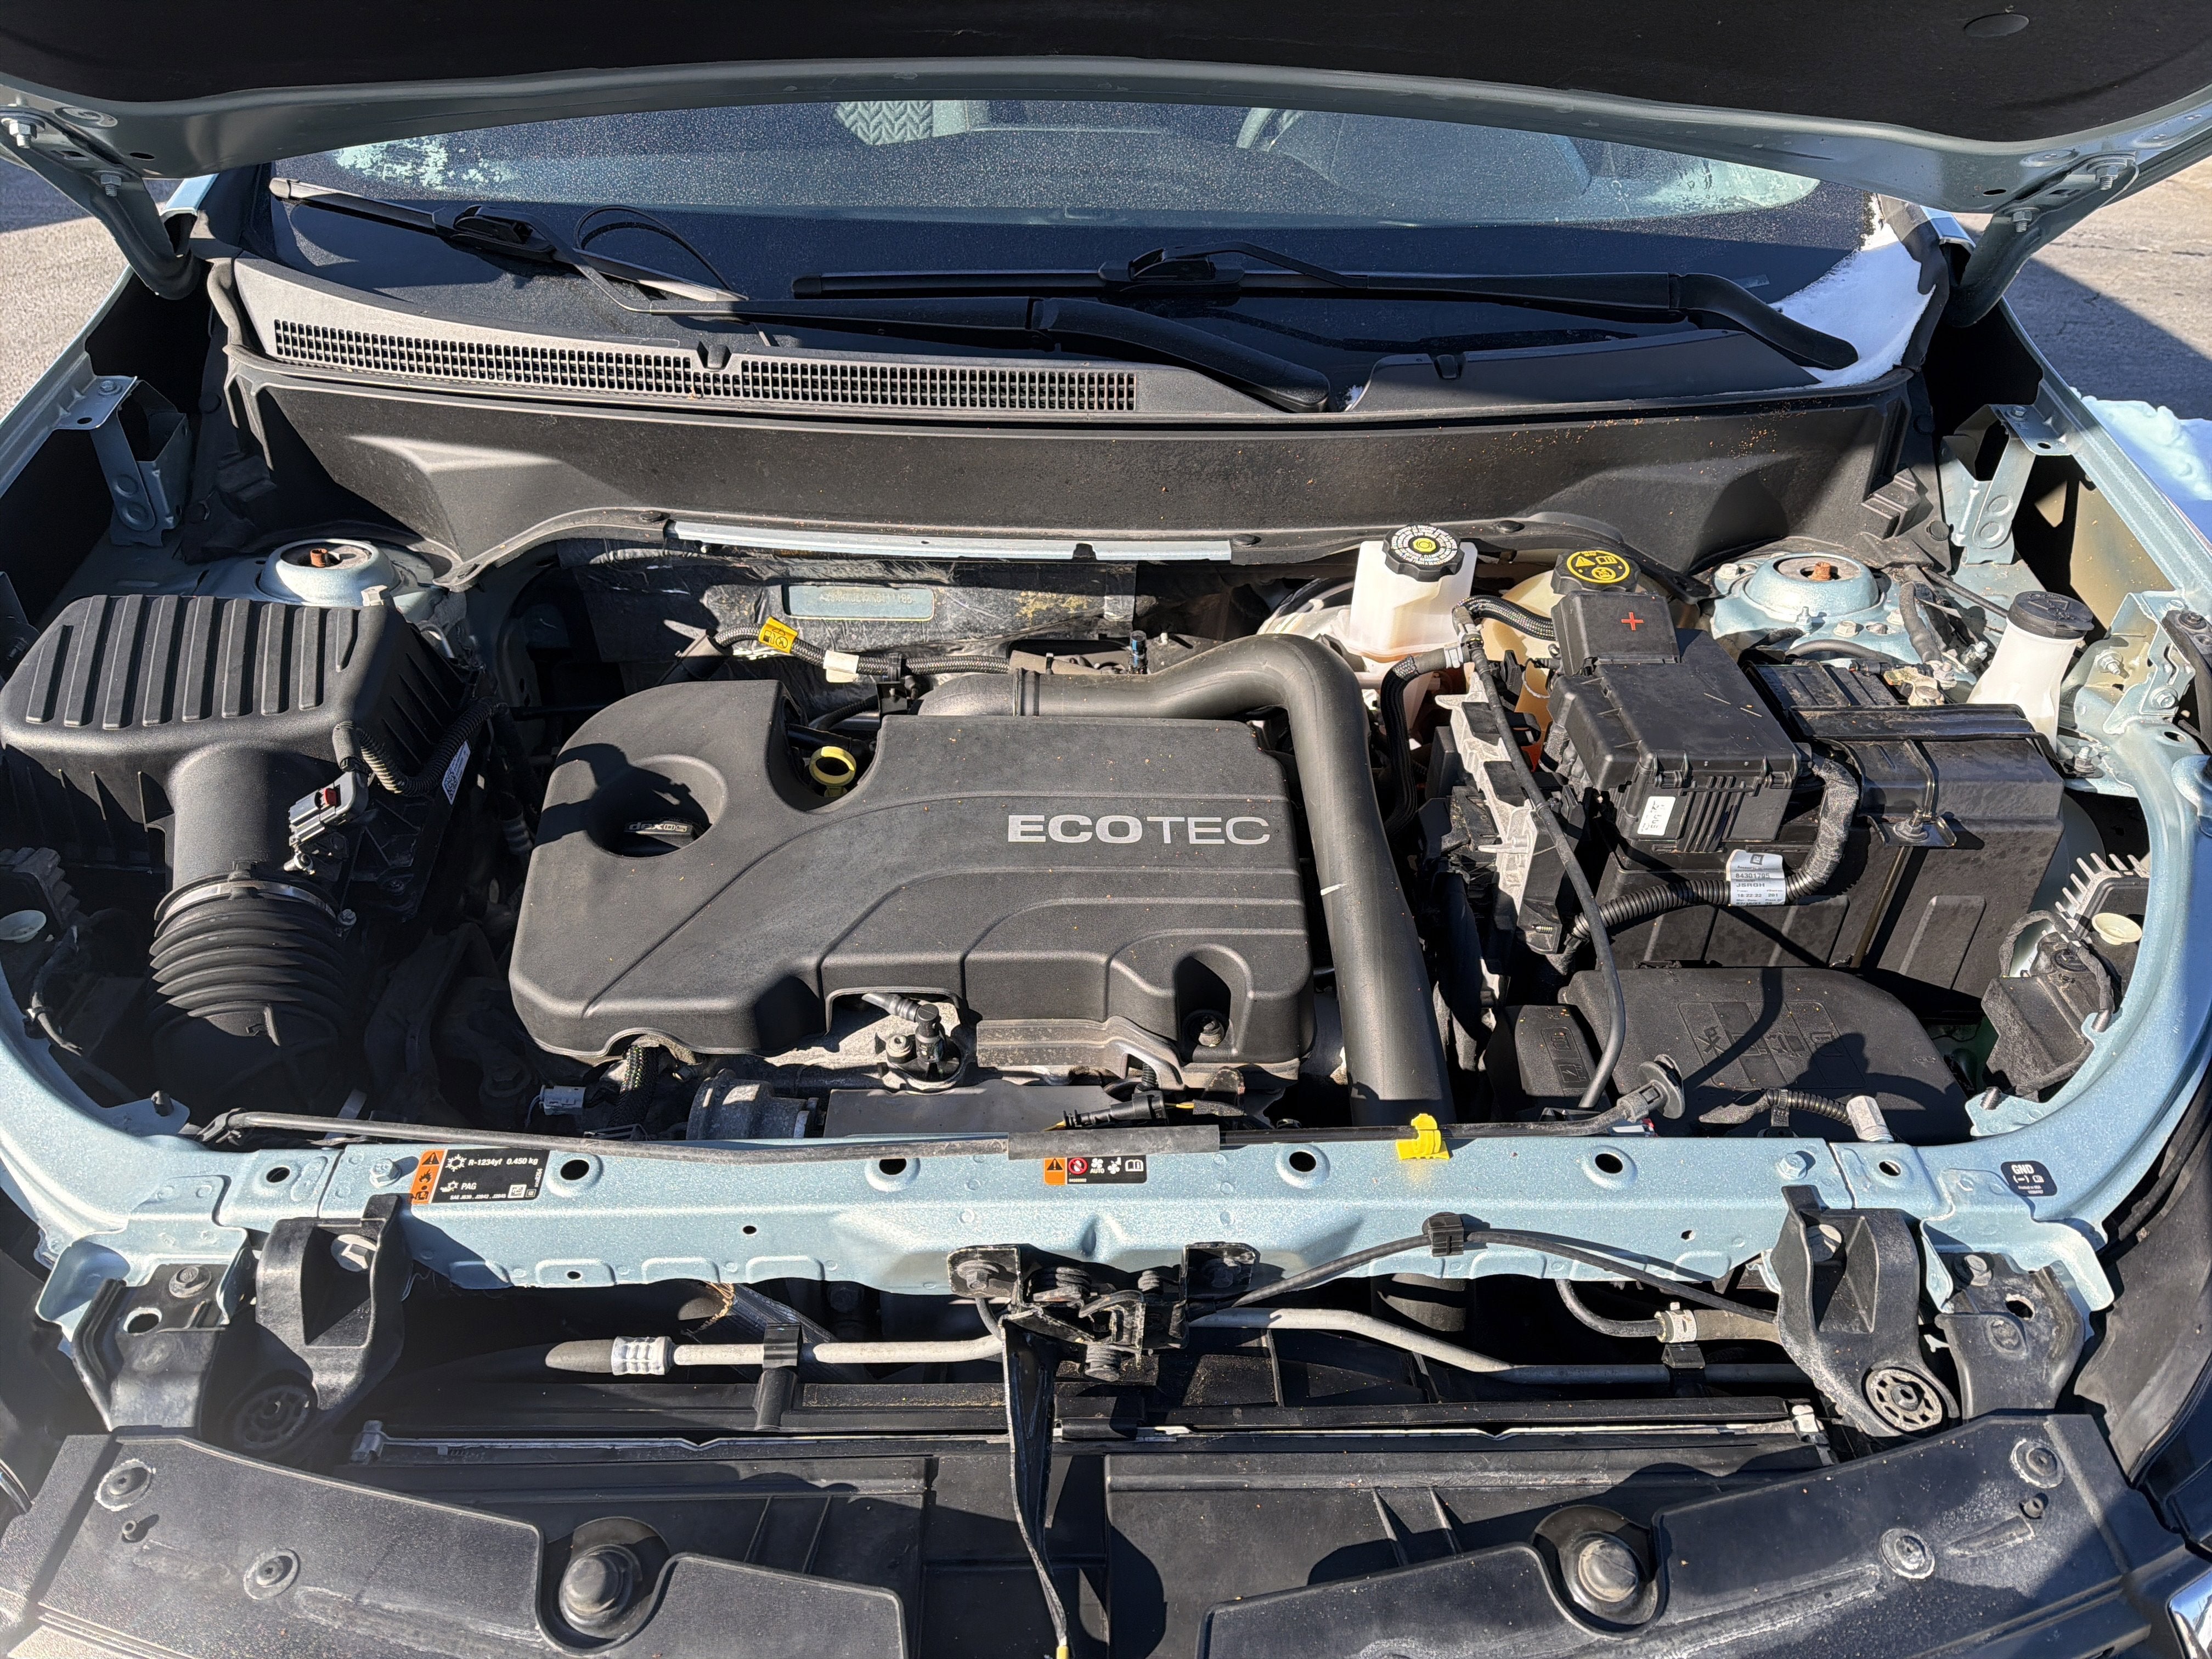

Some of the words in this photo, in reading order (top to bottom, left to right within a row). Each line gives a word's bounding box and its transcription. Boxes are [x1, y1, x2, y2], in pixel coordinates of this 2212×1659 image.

[629, 822, 688, 832] dexos
[1007, 814, 1271, 844] ECOTEC
[468, 1158, 503, 1166] R-1234yf
[528, 1158, 538, 1166] kg
[2011, 1164, 2035, 1174] GND
[461, 1182, 477, 1190] PAG
